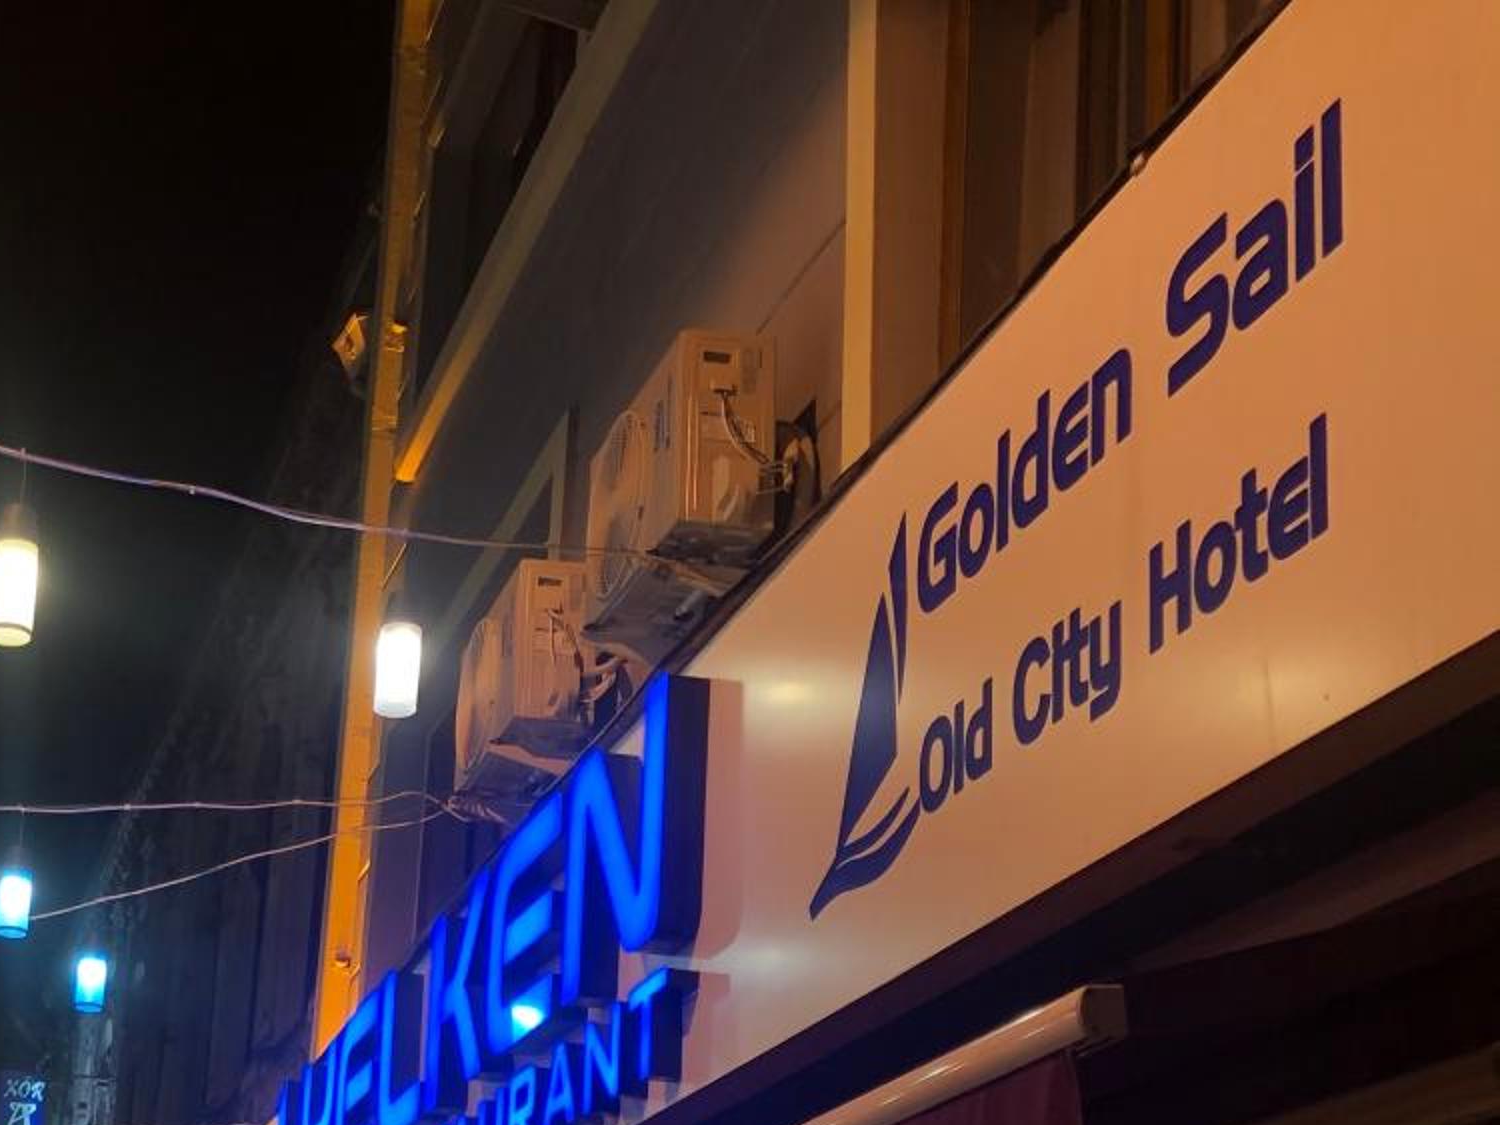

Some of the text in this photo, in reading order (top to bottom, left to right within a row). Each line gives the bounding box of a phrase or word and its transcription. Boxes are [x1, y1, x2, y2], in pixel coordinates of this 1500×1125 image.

[917, 97, 1345, 613] Golden Sail
[919, 411, 1330, 814] Old City Hotel
